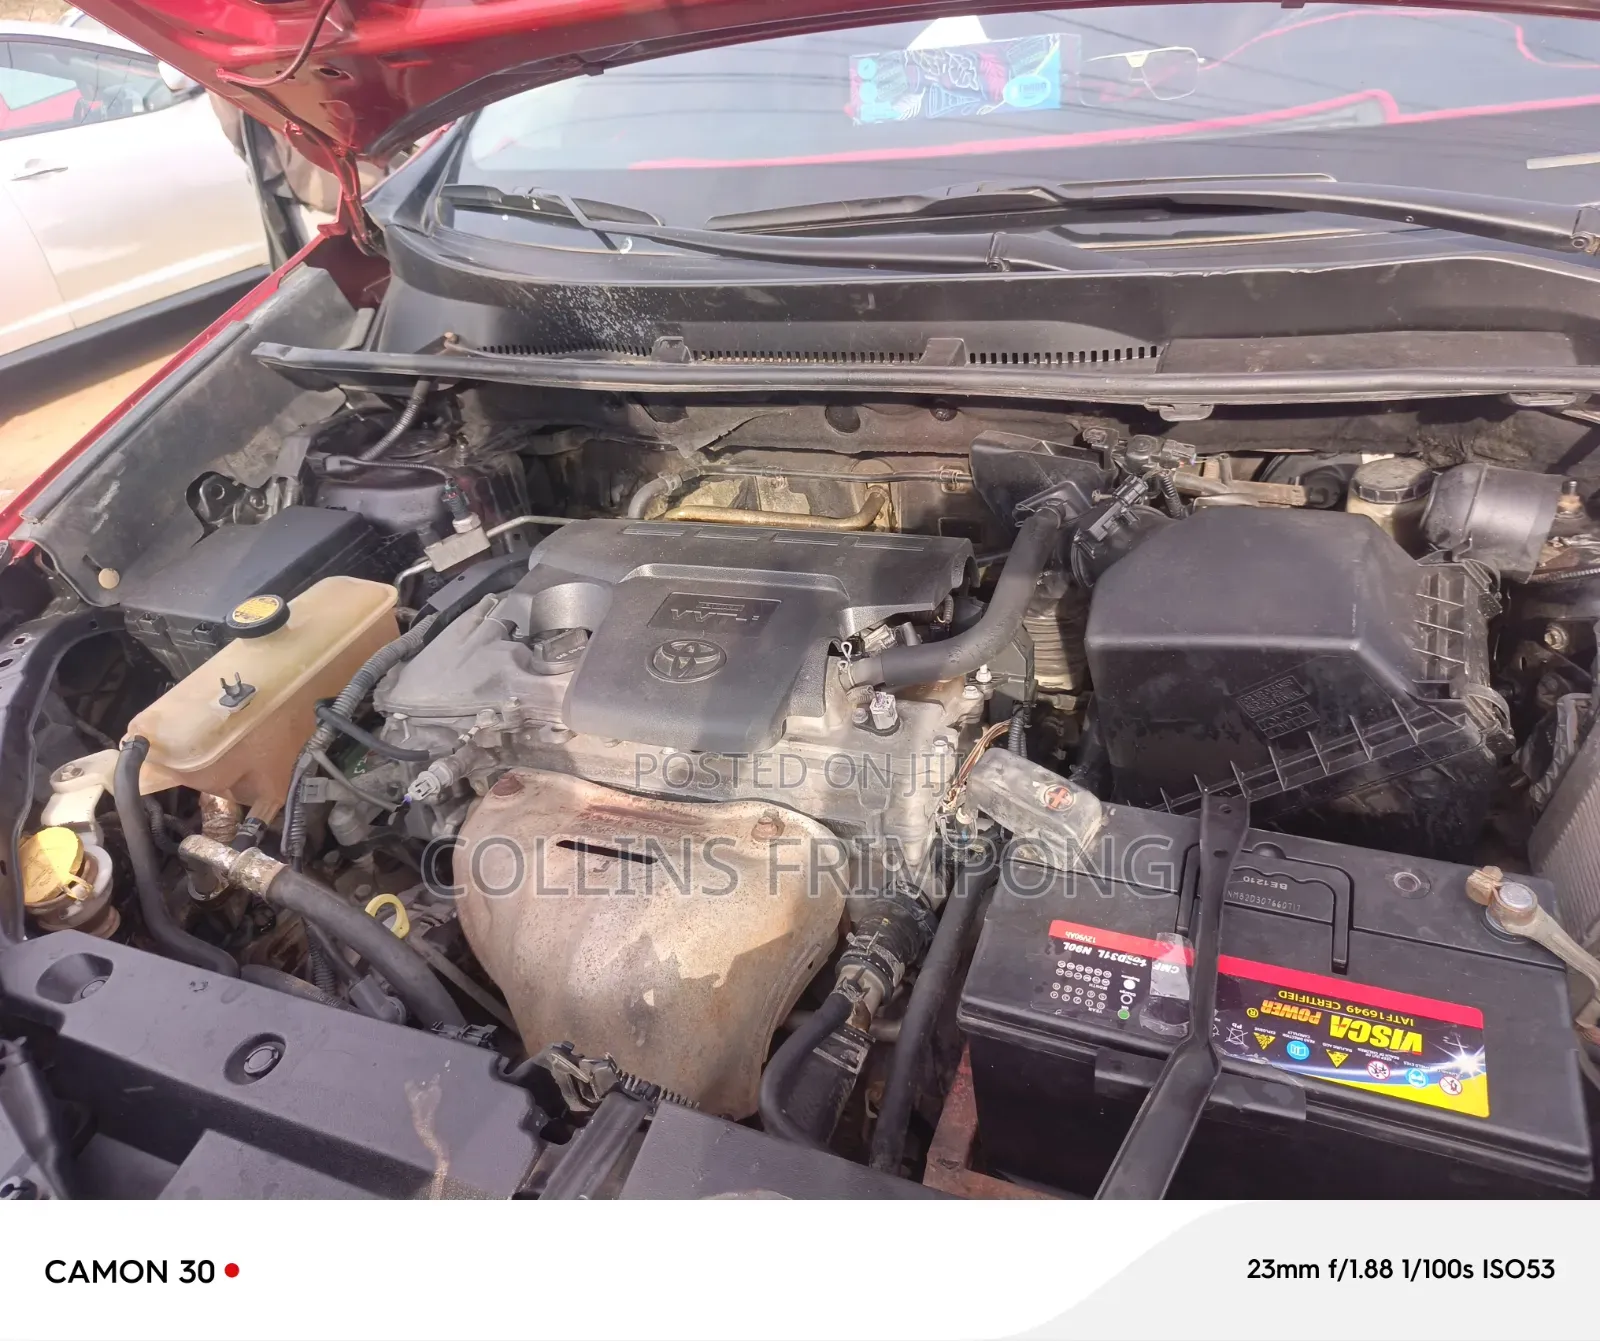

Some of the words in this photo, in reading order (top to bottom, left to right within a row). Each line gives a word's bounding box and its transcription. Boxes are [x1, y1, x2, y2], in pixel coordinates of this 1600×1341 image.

[1243, 876, 1288, 890] BE1210
[1065, 931, 1096, 943] 12V90Ah
[1063, 941, 1093, 955] N90L
[1152, 962, 1180, 974] CMF
[1278, 990, 1341, 1010] CERTIFIED
[1260, 999, 1322, 1025] POWER
[1345, 1005, 1414, 1026] IATF16949
[1231, 1022, 1243, 1030] Pb
[1329, 1014, 1423, 1055] VISCA
